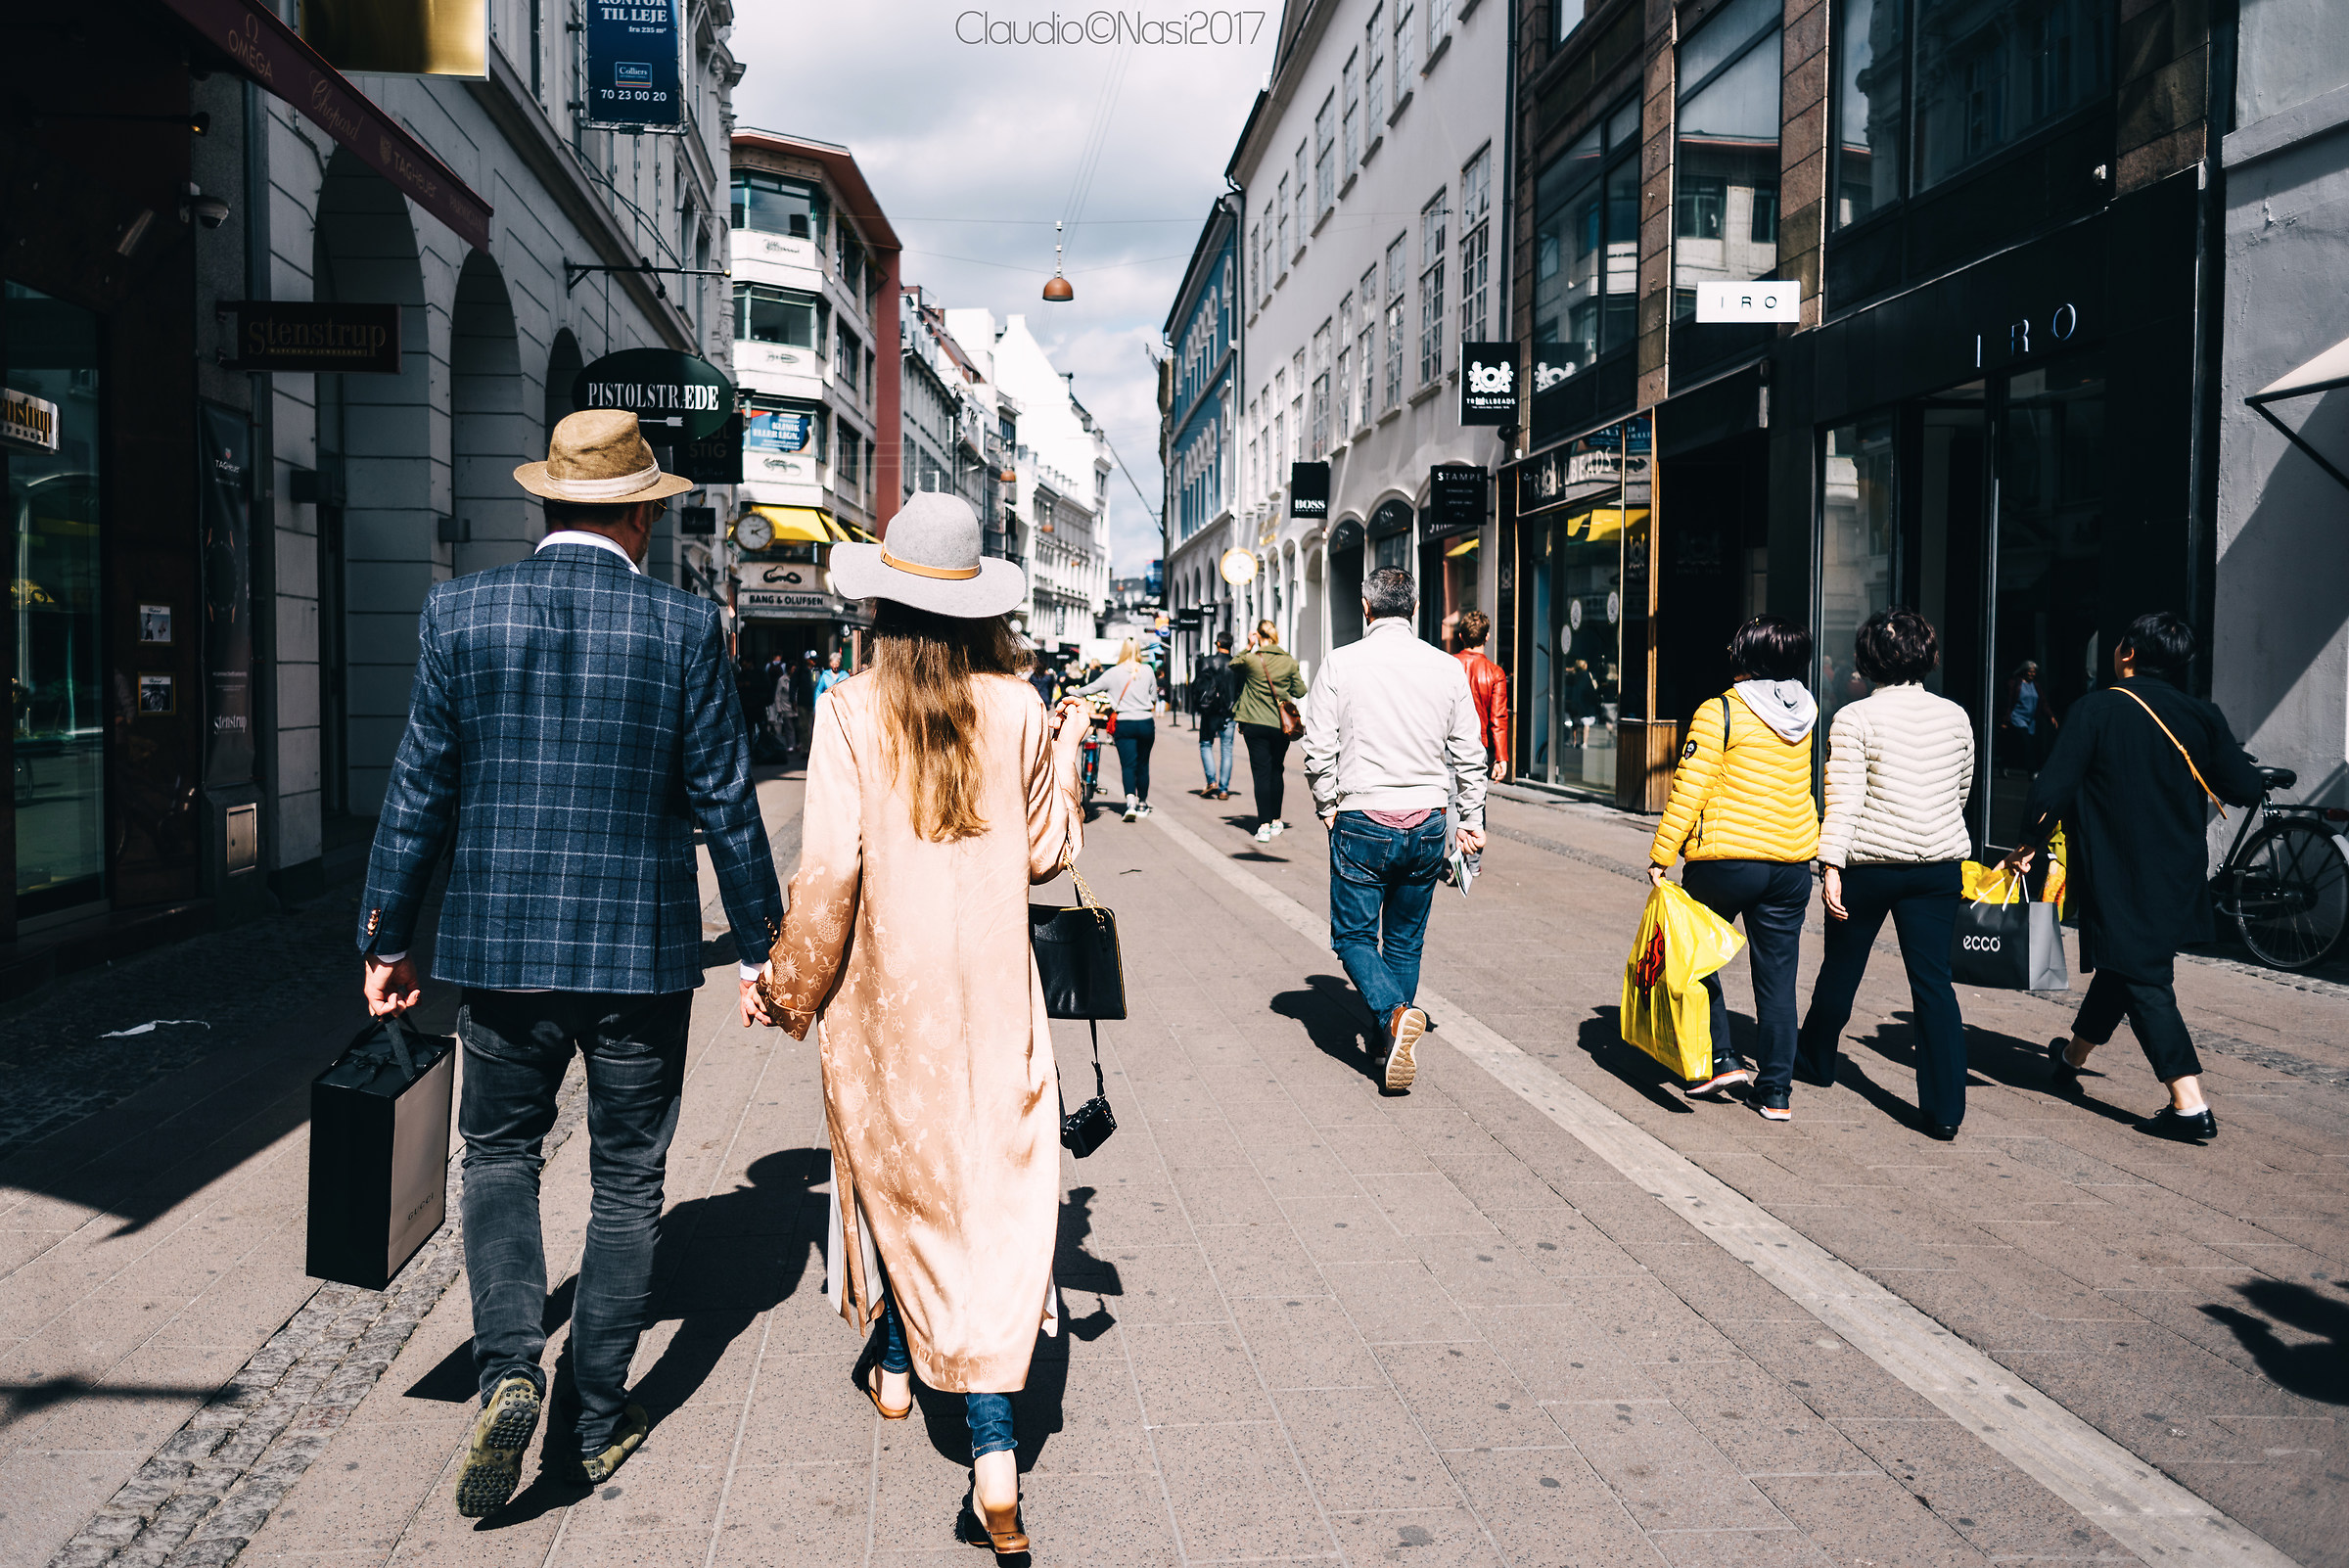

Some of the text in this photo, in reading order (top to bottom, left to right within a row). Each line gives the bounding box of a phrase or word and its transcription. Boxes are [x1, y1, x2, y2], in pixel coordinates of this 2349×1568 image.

[601, 7, 668, 23] TIL LEJE
[228, 29, 274, 83] OMEGA
[619, 66, 648, 76] Colliers
[600, 89, 668, 102] 70 23 00 20
[308, 69, 365, 142] Chopard
[1721, 296, 1777, 309] IRO
[1976, 302, 2078, 369] IRO
[587, 382, 720, 411] PISTOLSTRÆDE
[688, 442, 727, 459] STIG
[1437, 471, 1482, 482] STAMPE
[1294, 499, 1326, 510] BOSS
[750, 594, 824, 606] BANG & OLUFSEN
[1962, 935, 2001, 952] ecco
[407, 1191, 435, 1221] GUCCI
